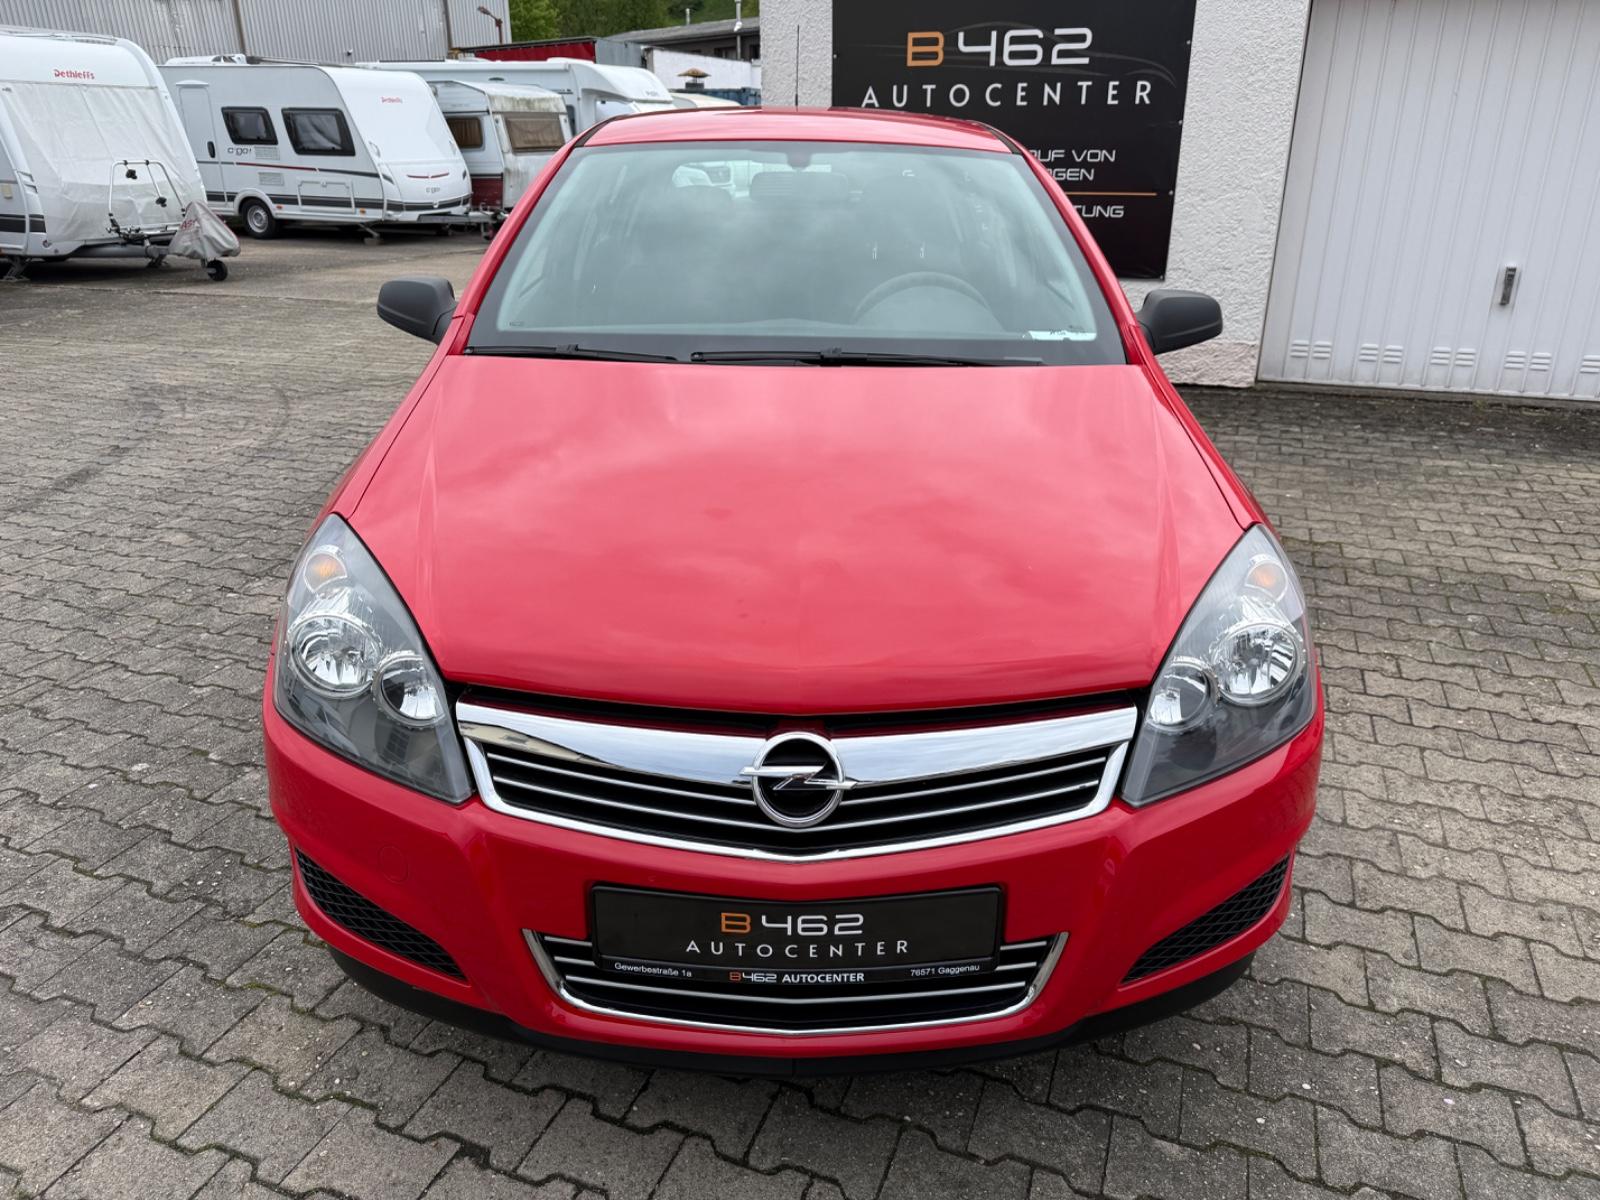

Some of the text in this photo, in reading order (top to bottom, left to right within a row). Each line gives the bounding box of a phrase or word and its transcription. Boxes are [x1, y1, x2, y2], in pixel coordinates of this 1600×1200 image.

[906, 27, 1093, 67] B 462
[861, 80, 1152, 108] AUTOCENTER
[1072, 149, 1116, 162] VON
[1046, 168, 1095, 181] GEN
[720, 912, 864, 936] B 462
[686, 939, 908, 958] AUTOCENTER
[614, 962, 679, 977] Gewerbestraße
[782, 973, 865, 983] AUTOCENTER
